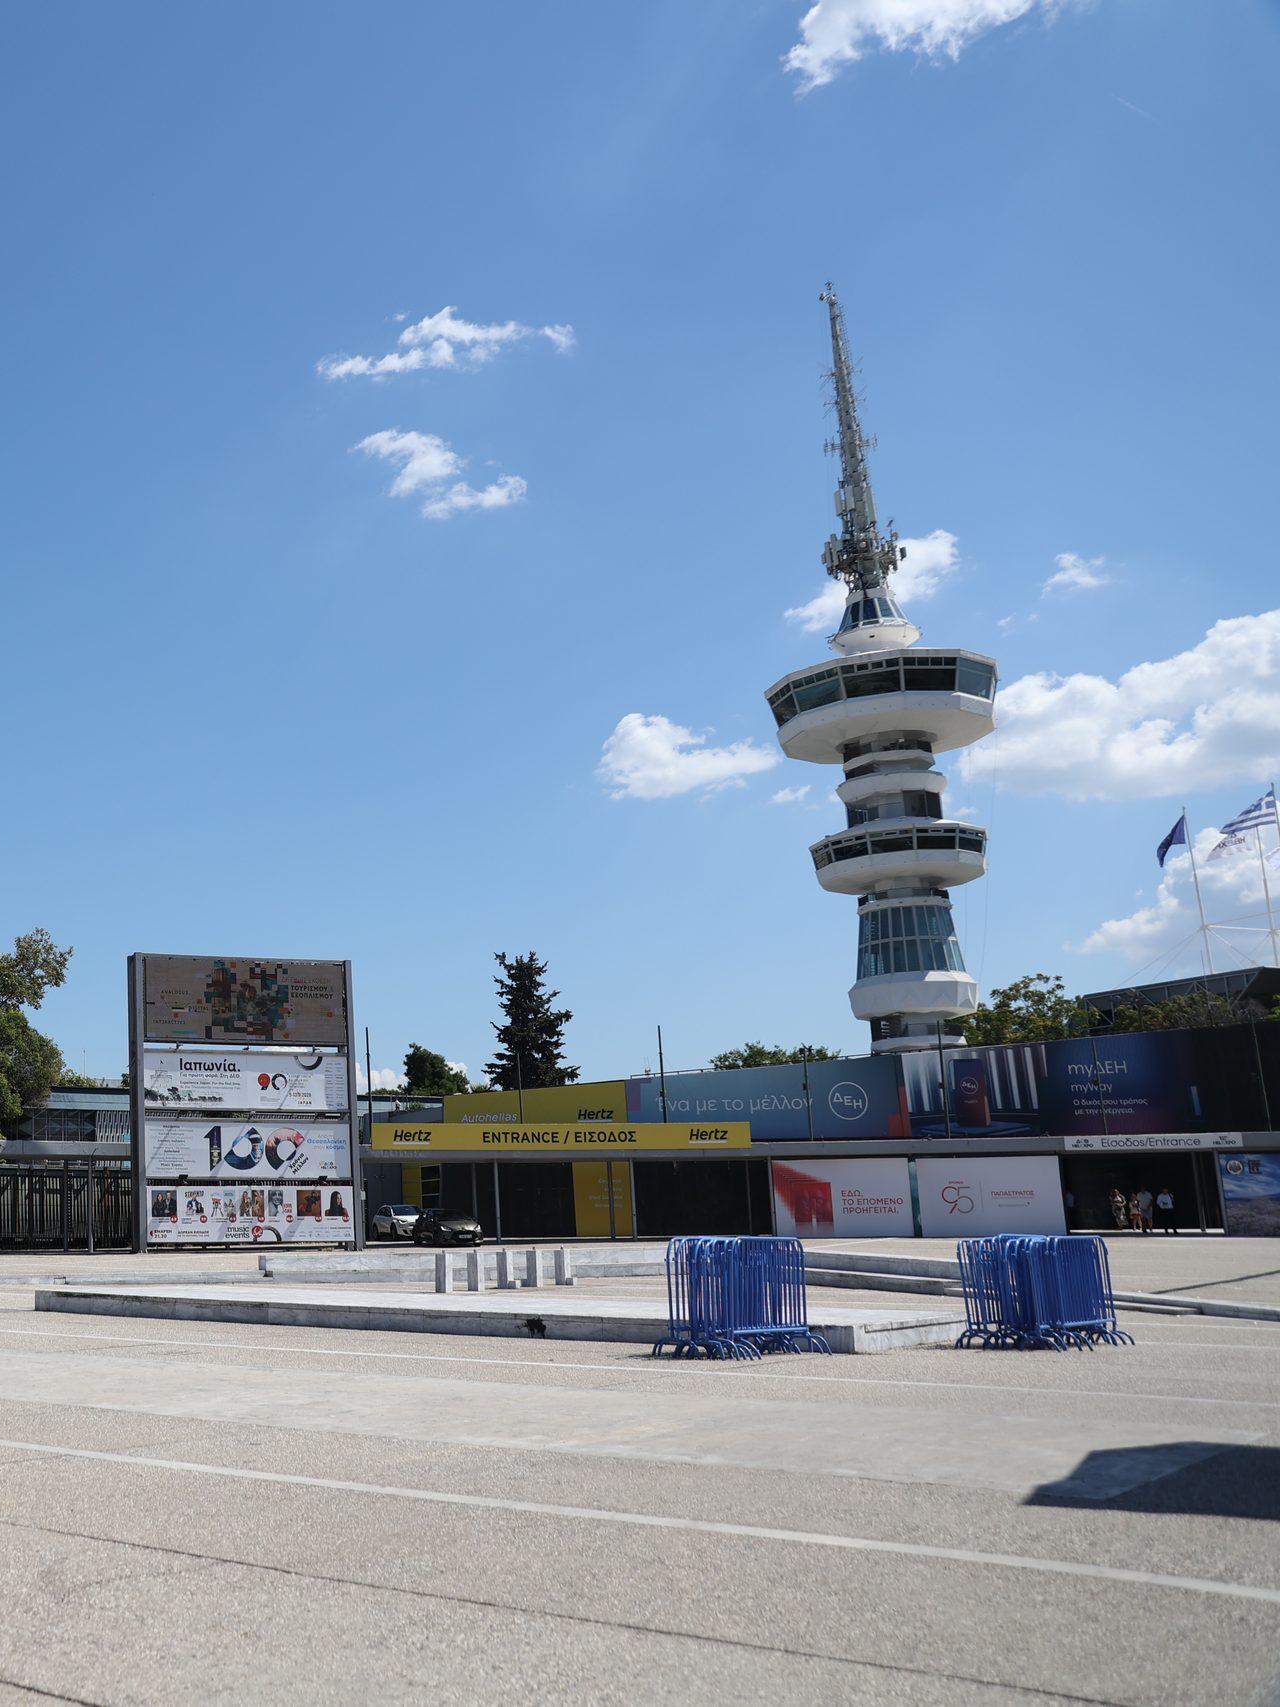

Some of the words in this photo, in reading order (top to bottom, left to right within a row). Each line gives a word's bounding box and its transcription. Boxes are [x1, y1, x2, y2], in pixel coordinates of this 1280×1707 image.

[179, 1058, 241, 1072] Ιαπωνία.
[696, 1099, 718, 1115] με
[721, 1099, 744, 1111] το
[750, 1094, 814, 1114] μέλλον
[832, 1092, 863, 1109] ΔΕΗ
[461, 1112, 518, 1123] Autohellas
[577, 1108, 614, 1120] Hertz
[393, 1129, 432, 1142] Hertz
[482, 1131, 560, 1144] ENTRANCE
[574, 1131, 637, 1143] ΕΙΣΟΔΟΣ
[689, 1128, 729, 1140] Hertz
[841, 1190, 864, 1199] ΕΔΩ,
[842, 1198, 855, 1206] ΤΟ
[856, 1197, 904, 1206] ΕΠΟΜΕΝΟ
[842, 1206, 900, 1214] ΠΡΟΗΓΕΙΤΑΙ.
